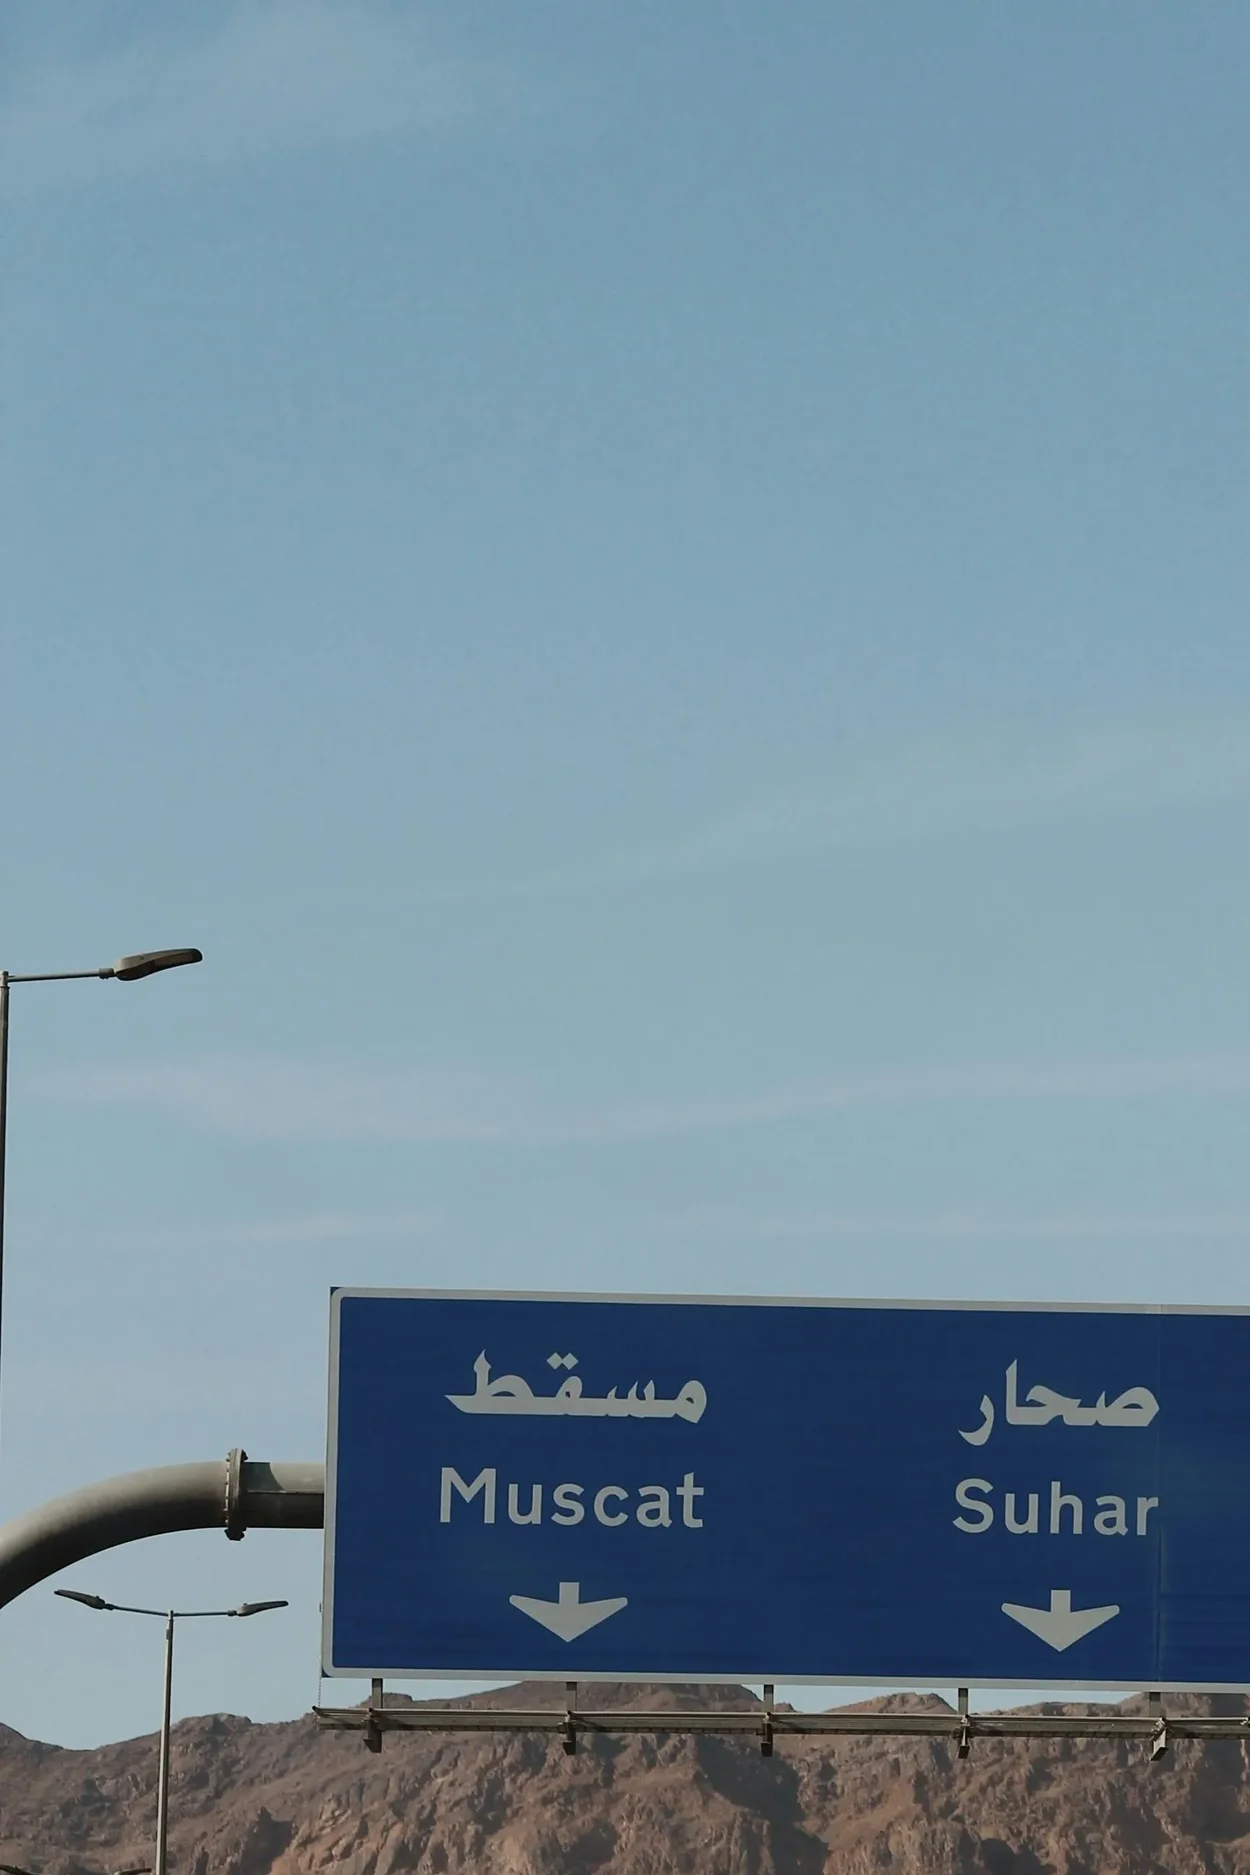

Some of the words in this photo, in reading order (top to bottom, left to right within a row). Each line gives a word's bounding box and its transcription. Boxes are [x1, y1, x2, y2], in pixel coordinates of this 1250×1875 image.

[444, 1349, 708, 1424] مسقط
[958, 1359, 1160, 1446] صحار
[439, 1466, 705, 1529] Muscat
[952, 1478, 1159, 1536] Suhar
